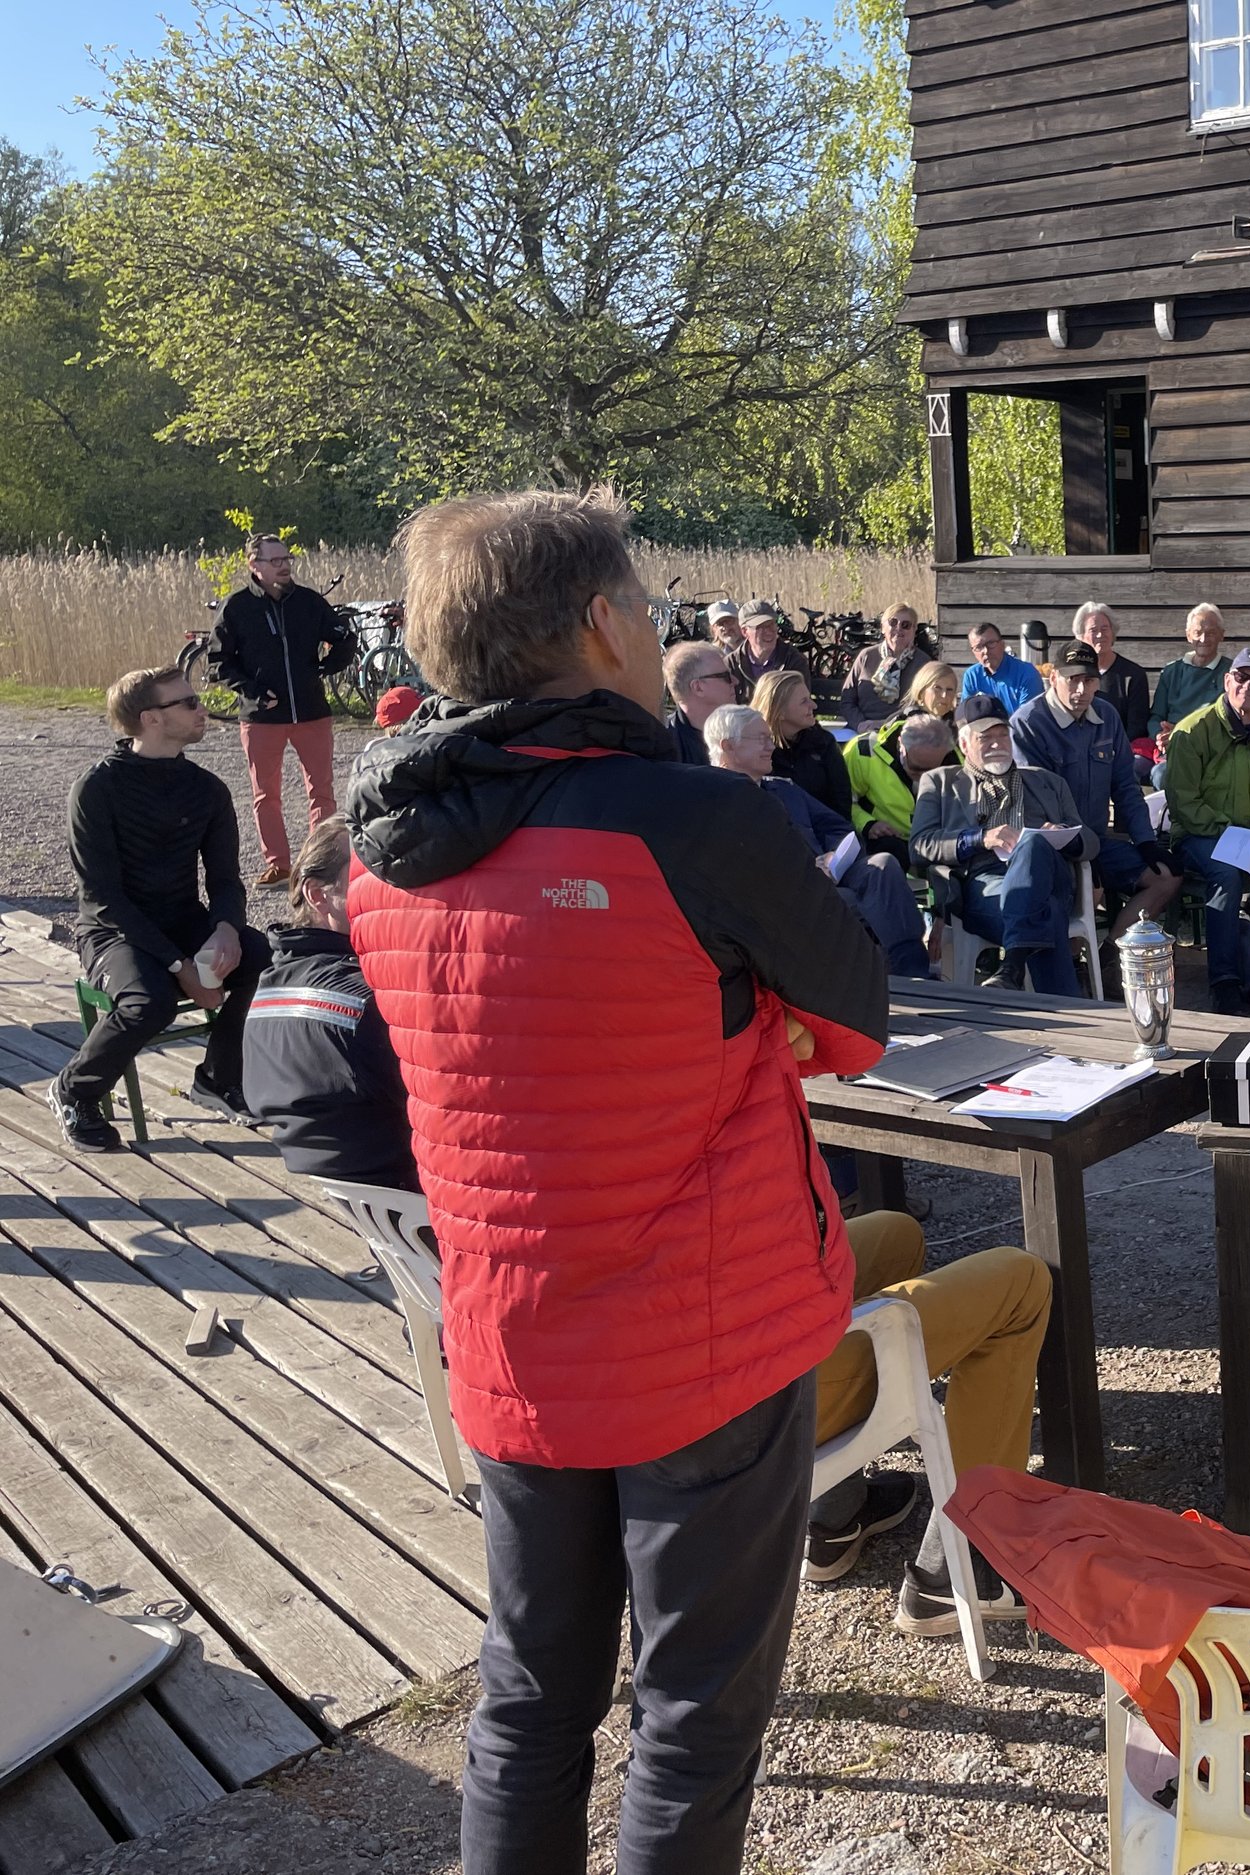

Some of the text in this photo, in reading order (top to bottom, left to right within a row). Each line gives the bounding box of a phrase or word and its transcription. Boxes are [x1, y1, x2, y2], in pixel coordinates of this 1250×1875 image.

[560, 879, 586, 889] THE
[542, 887, 586, 899] NORTH
[552, 898, 586, 909] FACE
